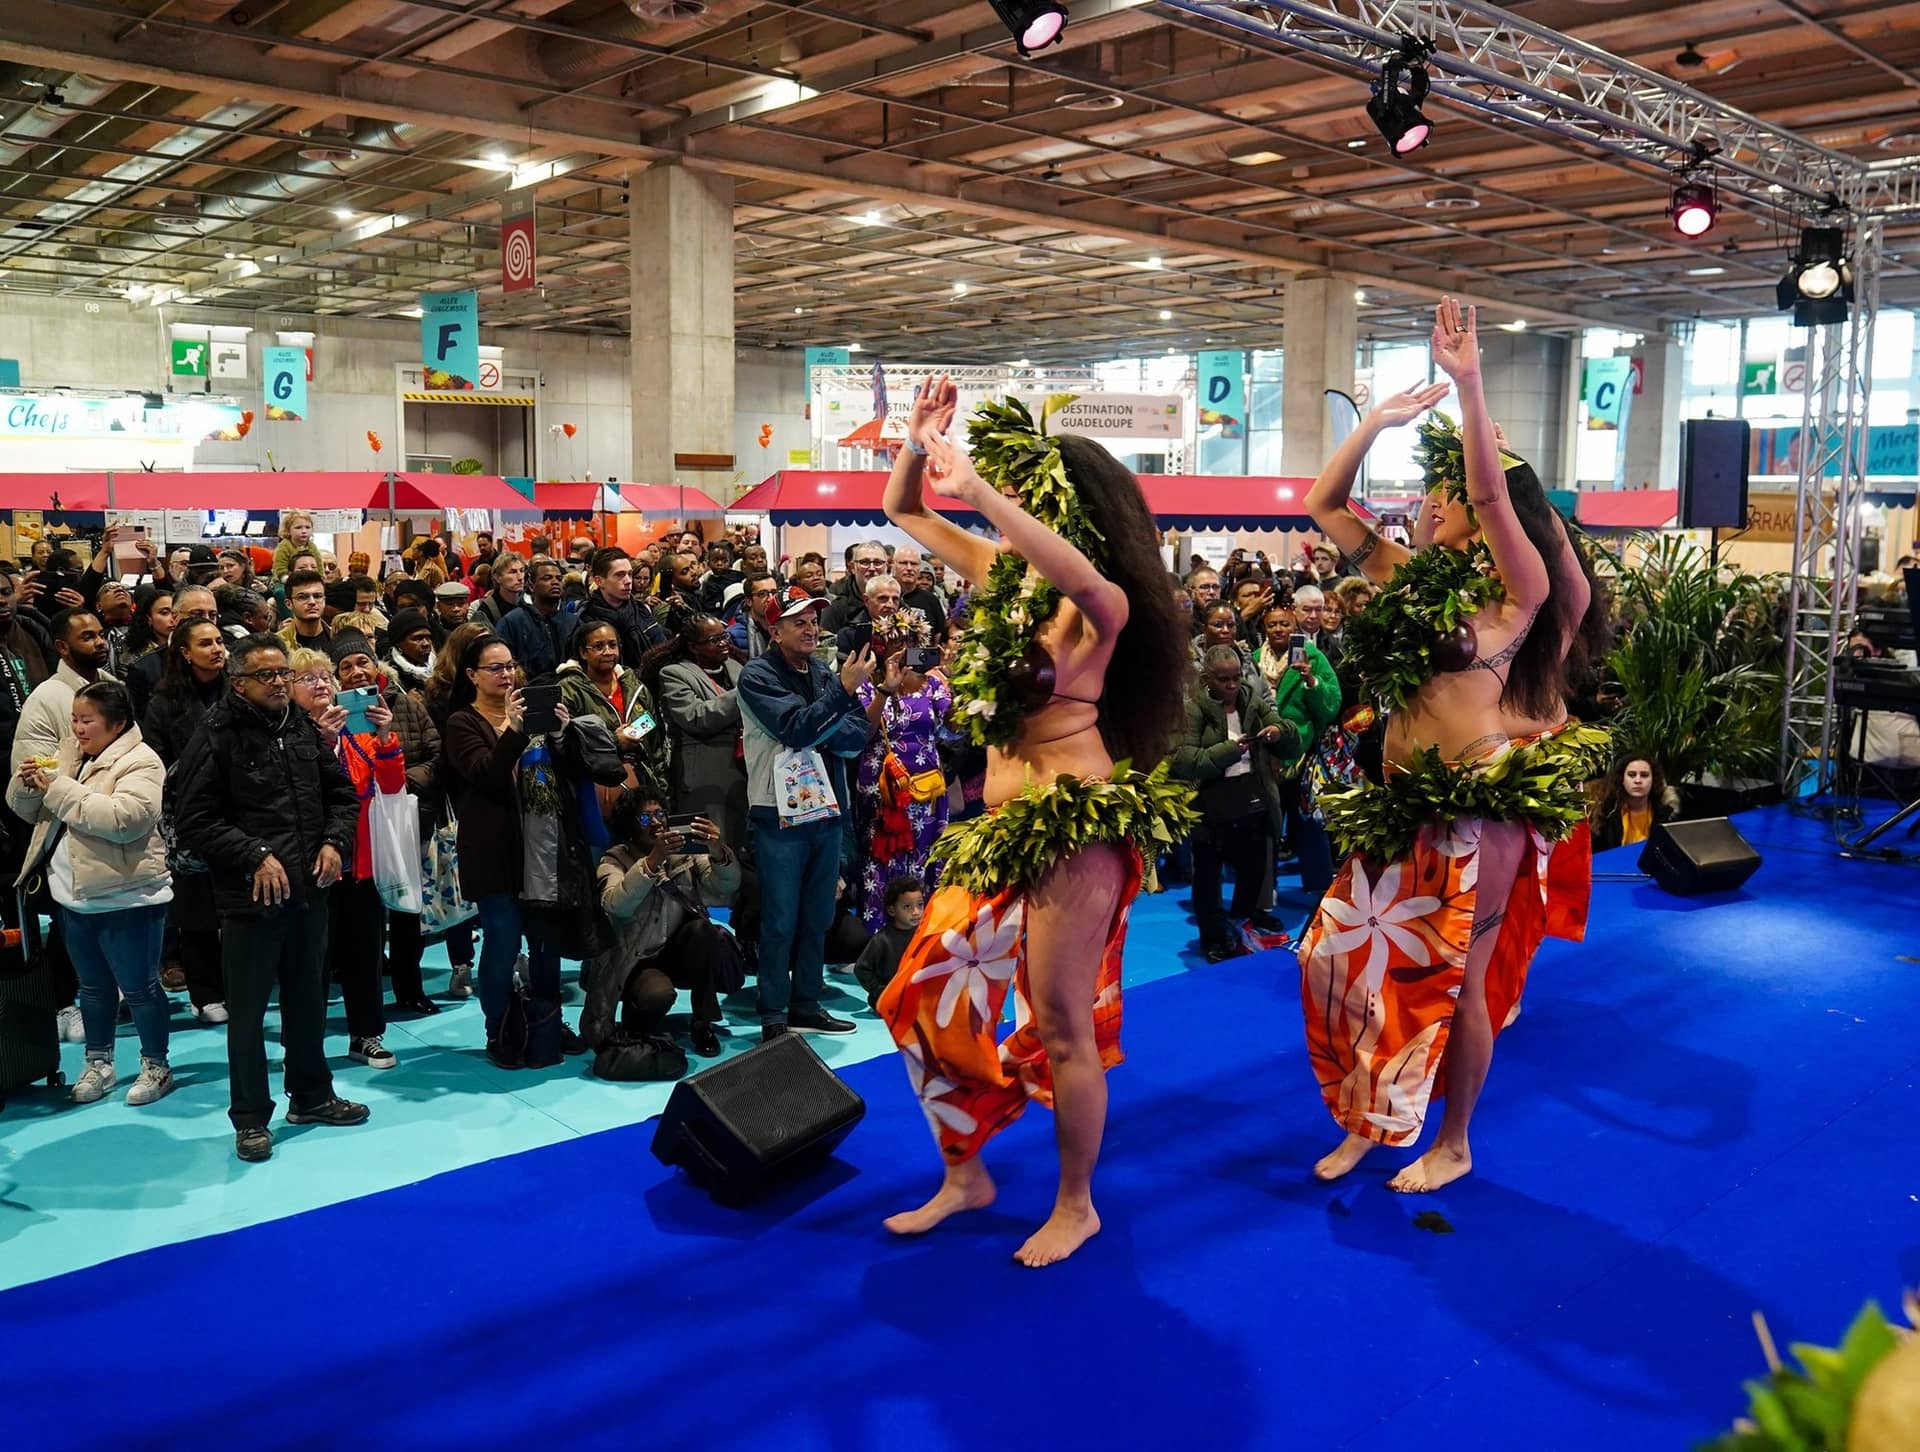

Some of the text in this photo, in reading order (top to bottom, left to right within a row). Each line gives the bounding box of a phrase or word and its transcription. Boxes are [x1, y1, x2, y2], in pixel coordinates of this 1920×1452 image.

[84, 302, 100, 313] 08
[280, 317, 293, 326] 07
[437, 323, 462, 361] F
[273, 371, 293, 400] G
[1208, 376, 1231, 404] D
[1595, 382, 1615, 410] C
[1062, 404, 1133, 415] DESTINATION
[1061, 417, 1133, 428] GUADELOUPE
